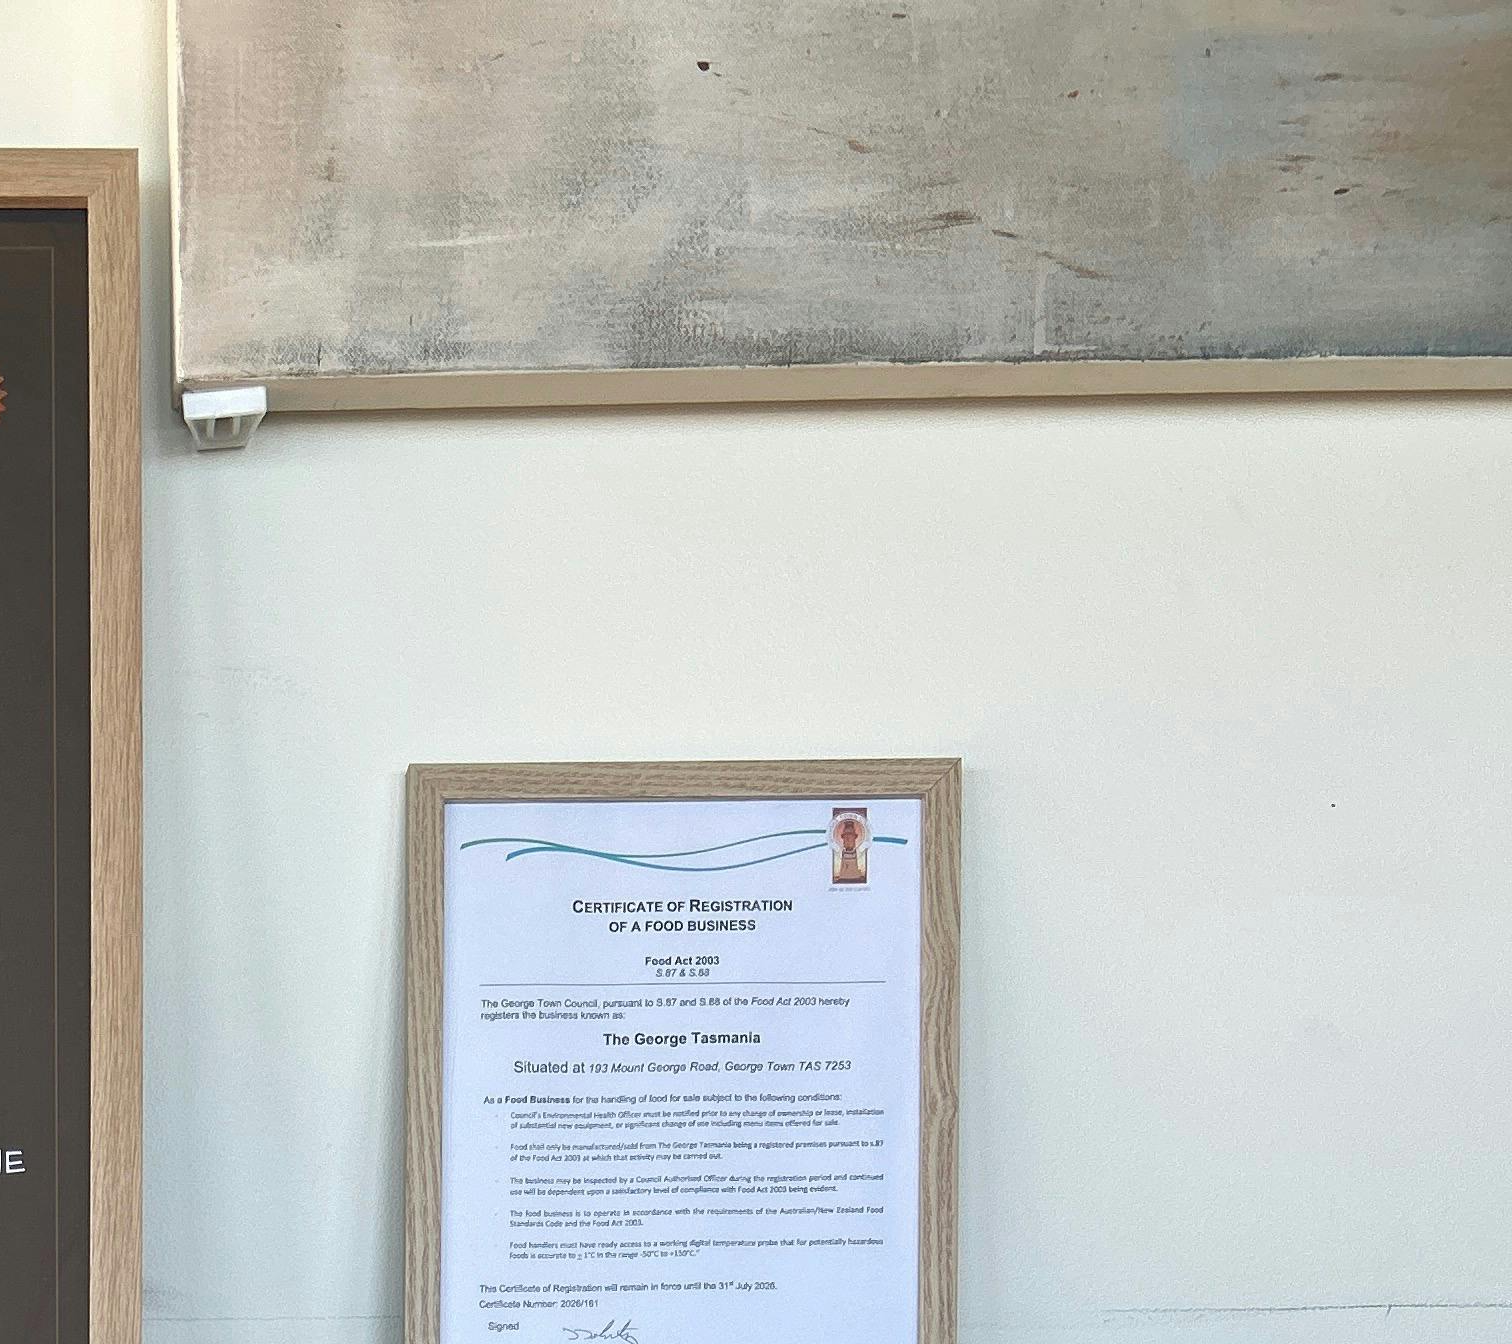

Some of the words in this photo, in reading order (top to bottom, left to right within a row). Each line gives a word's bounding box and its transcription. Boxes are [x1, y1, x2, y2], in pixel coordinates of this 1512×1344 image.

[572, 900, 663, 914] CERTIFICATE
[667, 902, 685, 912] OF
[689, 899, 793, 912] REGISTRATION
[609, 921, 627, 932] OF
[631, 921, 641, 932] A
[645, 920, 683, 932] FOOD
[687, 919, 756, 931] BUSINESS
[645, 957, 672, 966] Food
[675, 956, 692, 965] Act
[695, 956, 720, 965] 2003
[603, 1033, 630, 1046] The
[635, 1032, 687, 1049] George
[691, 1031, 761, 1044] Tasmania
